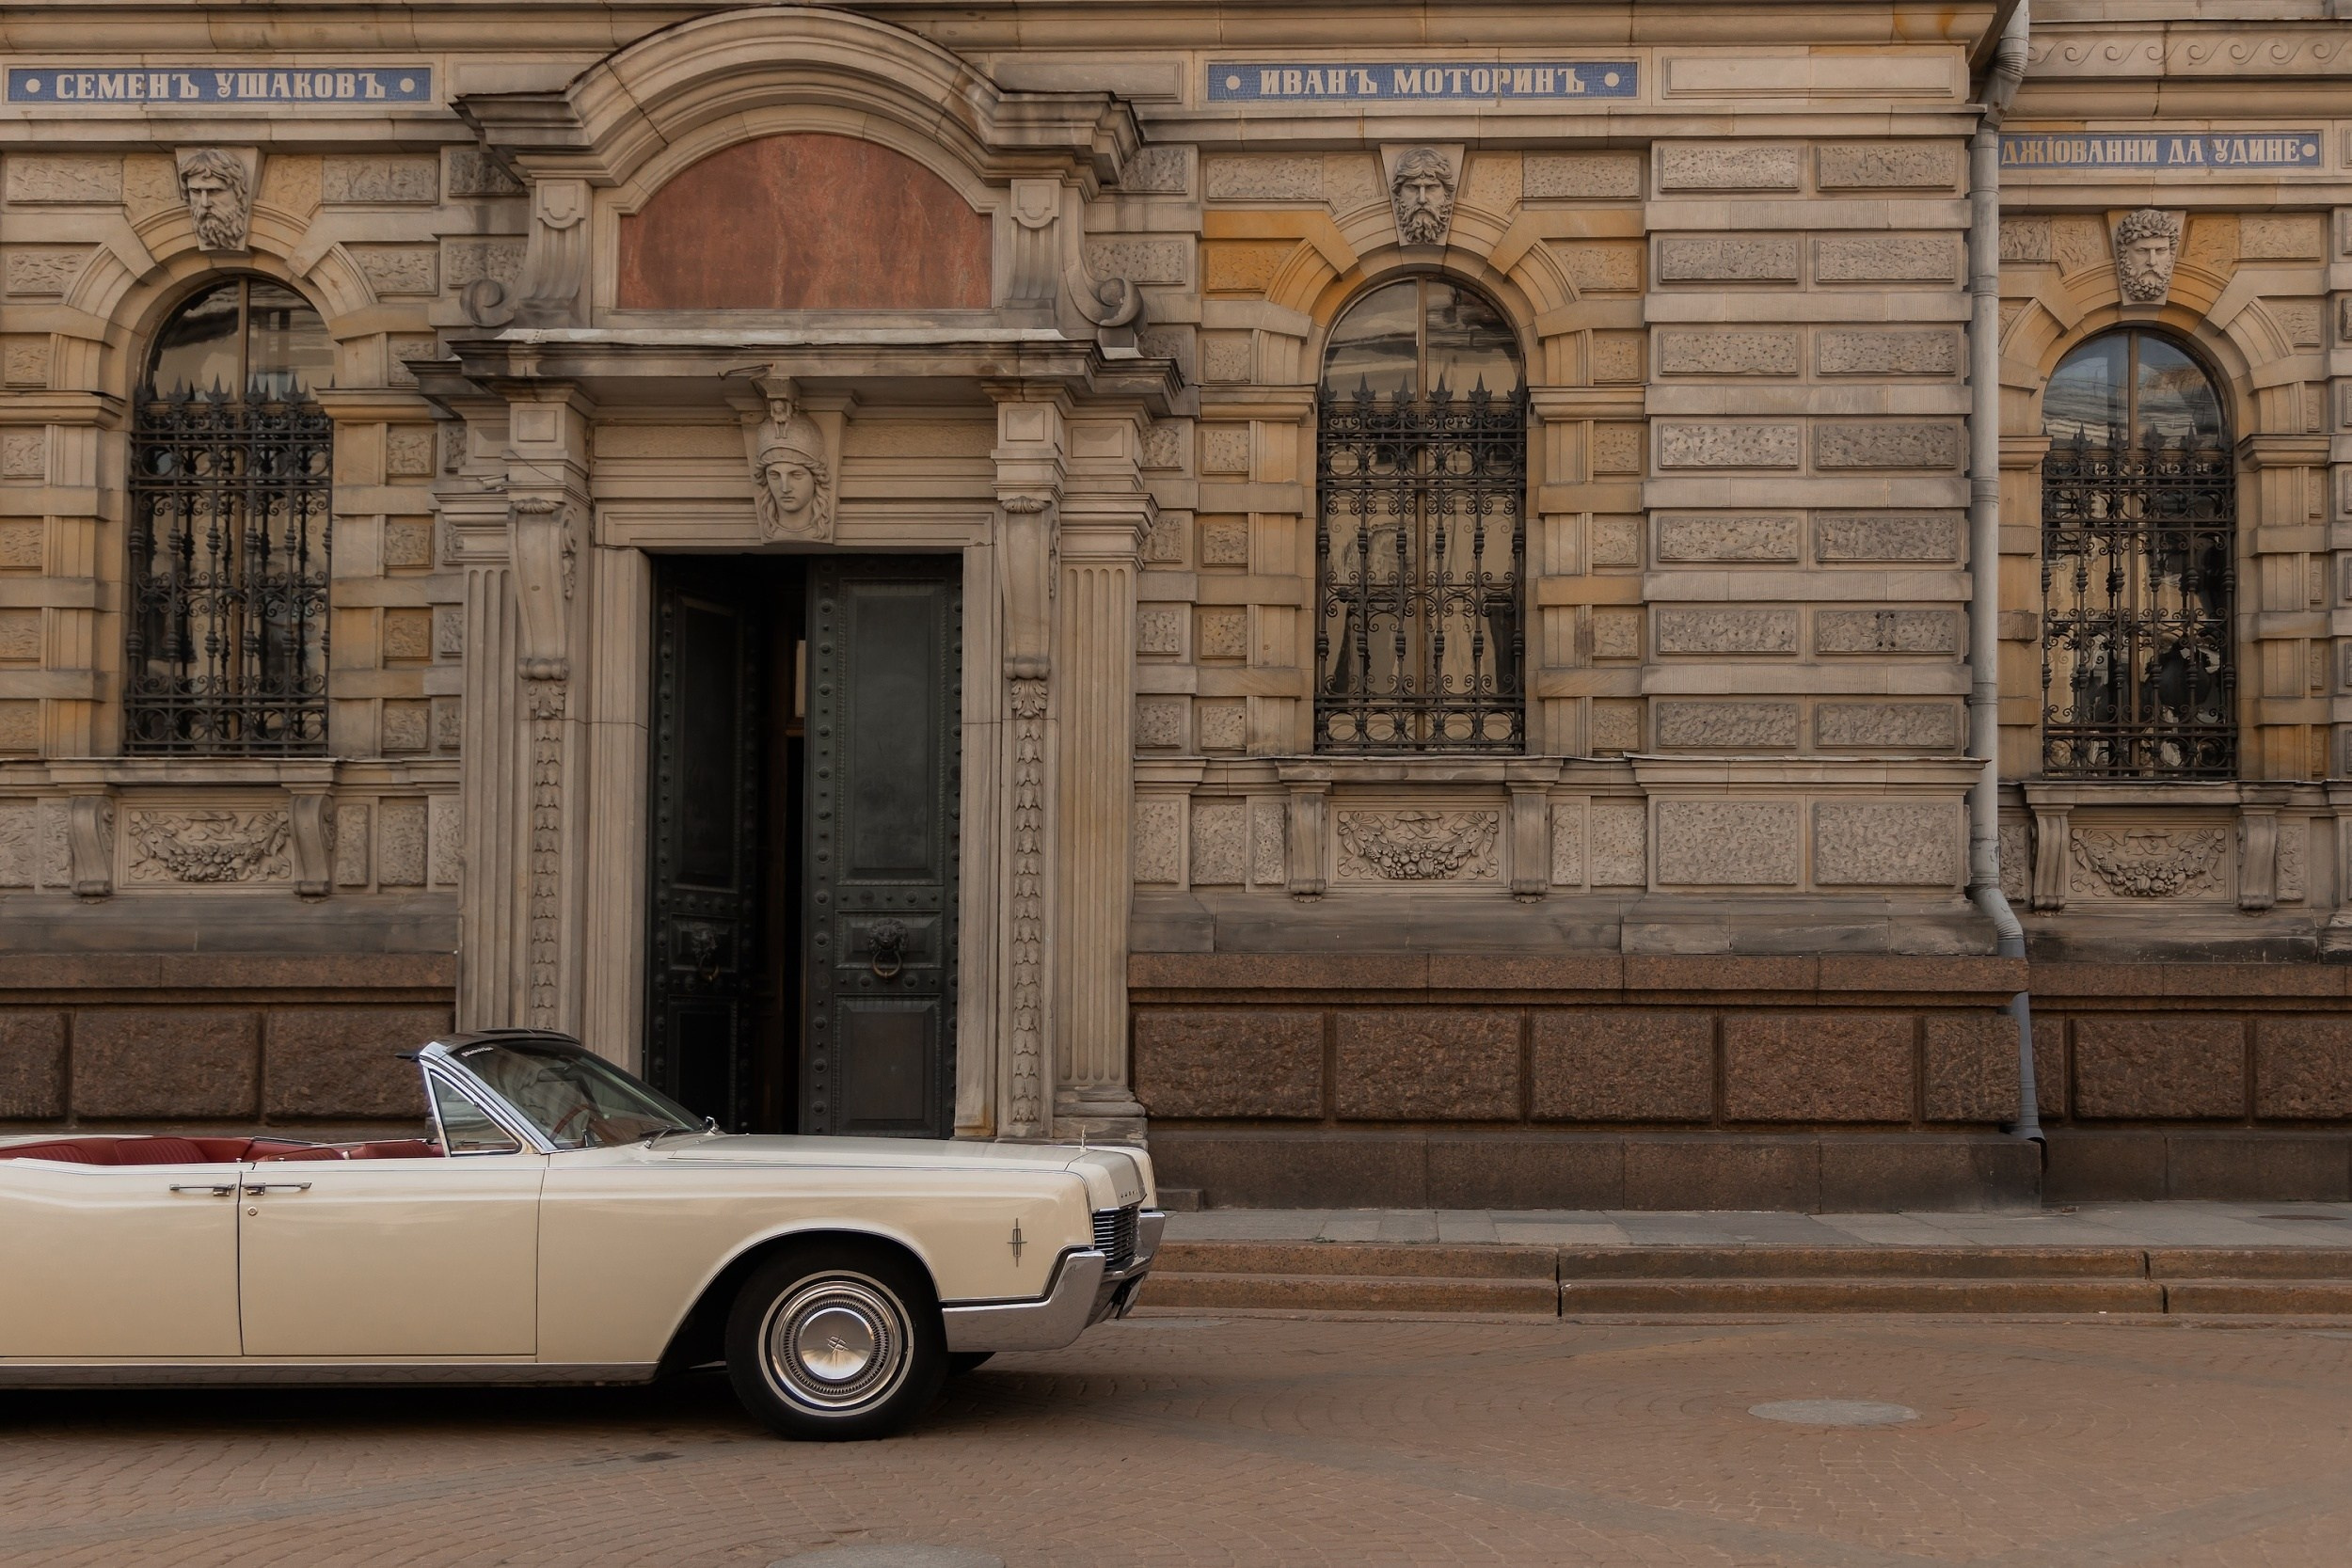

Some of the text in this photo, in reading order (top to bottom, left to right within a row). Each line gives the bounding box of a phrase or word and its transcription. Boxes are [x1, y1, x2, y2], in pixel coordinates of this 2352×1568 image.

[56, 72, 386, 99] СЕМЕНЪ УШАКОВЪ
[1261, 68, 1585, 94] ИВАНЪ МОТОРИНЪ
[2169, 139, 2204, 164] ДА
[2213, 139, 2300, 164] УДИНЕ
